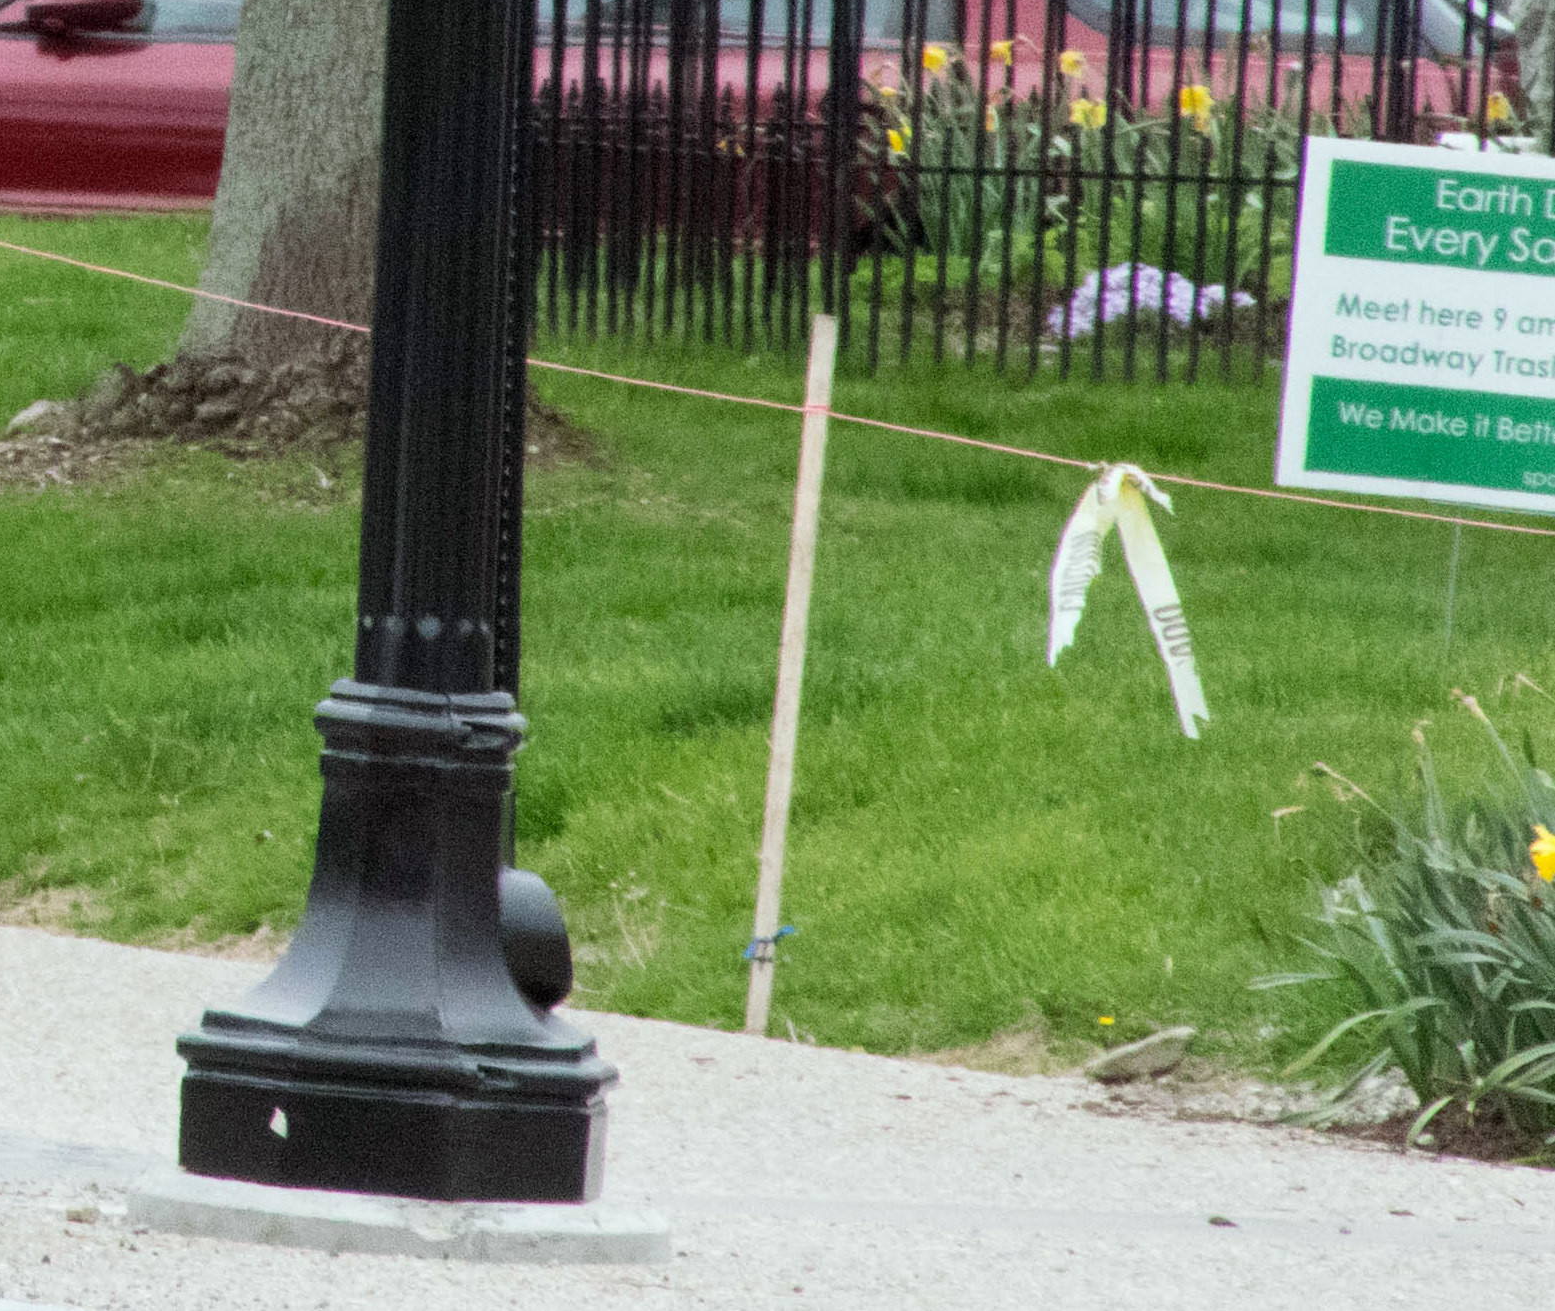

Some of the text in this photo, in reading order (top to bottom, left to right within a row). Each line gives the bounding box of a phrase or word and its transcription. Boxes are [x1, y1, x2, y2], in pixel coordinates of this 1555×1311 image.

[1436, 178, 1533, 217] Earth
[1386, 215, 1500, 266] Every
[1336, 292, 1411, 322] Meet
[1419, 299, 1483, 330] here
[1494, 307, 1508, 332] 9
[1331, 333, 1485, 377] Broadway
[1338, 400, 1385, 429] We
[1389, 406, 1469, 437] Make
[1474, 413, 1491, 439] it
